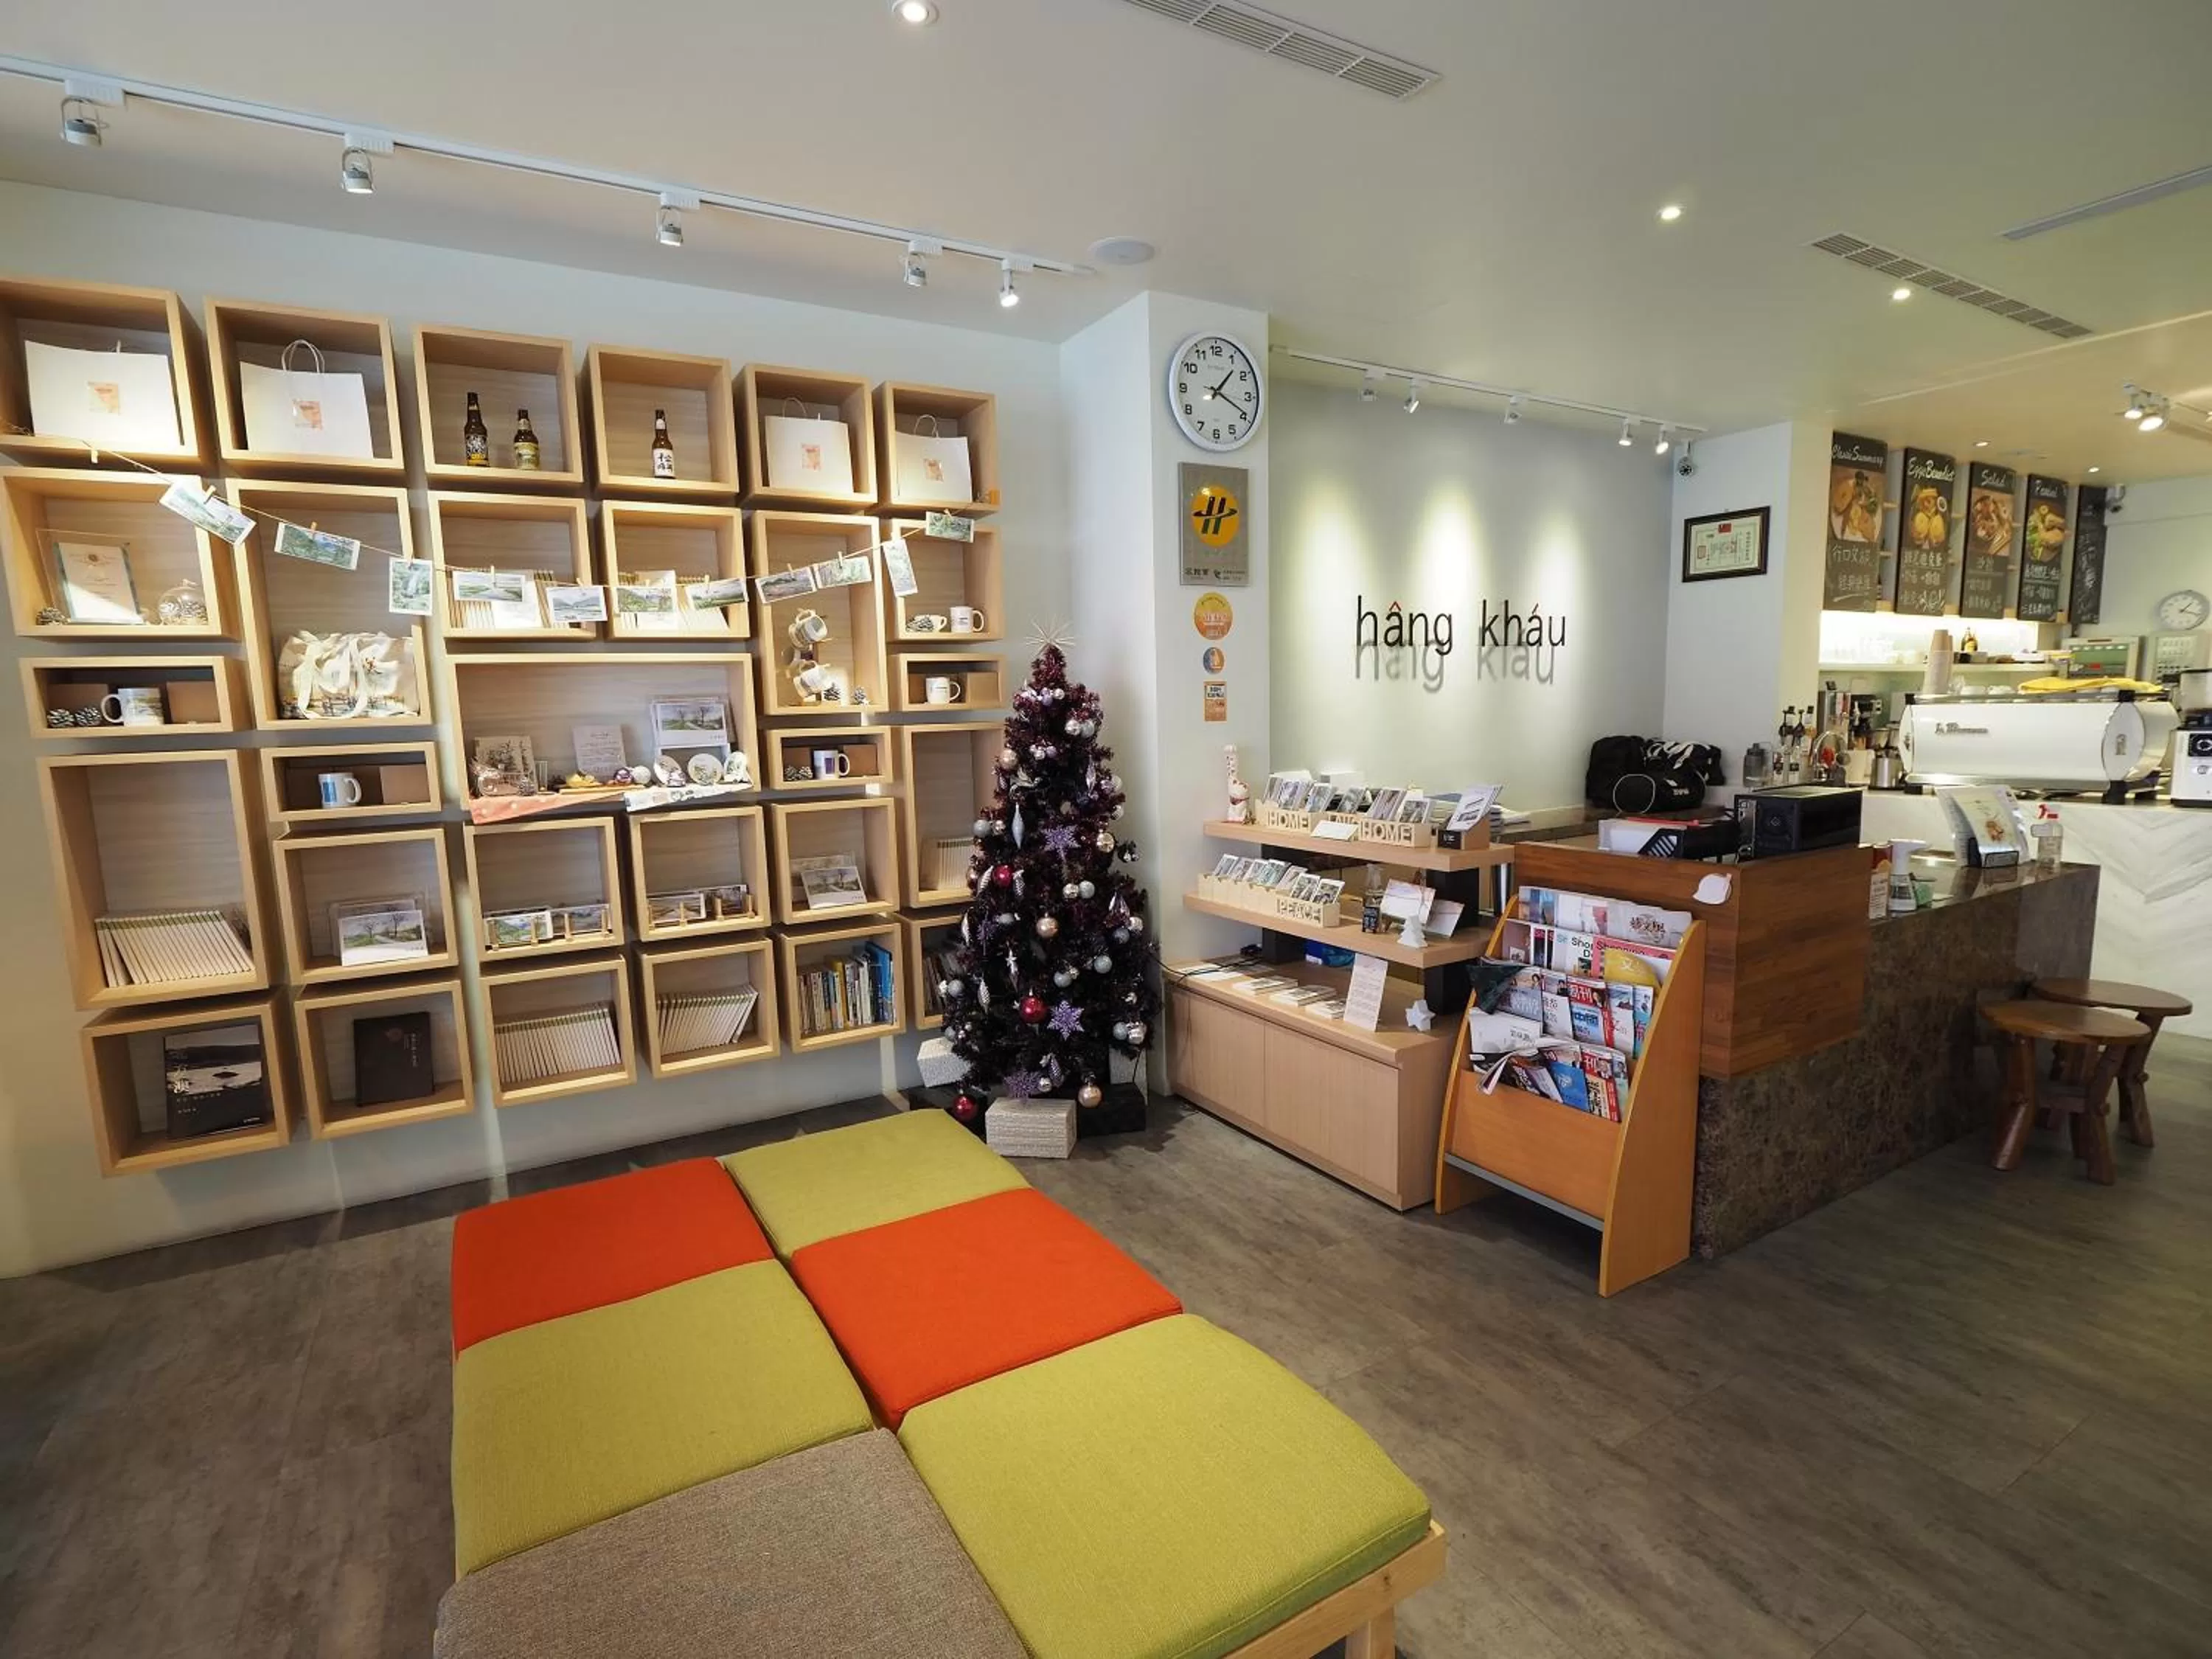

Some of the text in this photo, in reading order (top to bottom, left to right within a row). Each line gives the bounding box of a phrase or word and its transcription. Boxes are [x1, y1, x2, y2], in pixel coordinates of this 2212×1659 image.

[1195, 349, 1206, 361] 11
[1210, 345, 1222, 357] 12
[1229, 354, 1234, 364] 1
[1184, 362, 1197, 374] 10
[1240, 371, 1247, 381] 2
[1180, 383, 1188, 393] 9
[1245, 392, 1252, 402] 3
[1185, 404, 1192, 415] 8
[1239, 411, 1247, 421] 4
[1197, 421, 1205, 431] 7
[1228, 424, 1237, 434] 5
[1213, 428, 1220, 439] 6
[1356, 594, 1565, 655] hâng kháu
[1267, 811, 1310, 831] HOME
[1360, 820, 1413, 846] HOME
